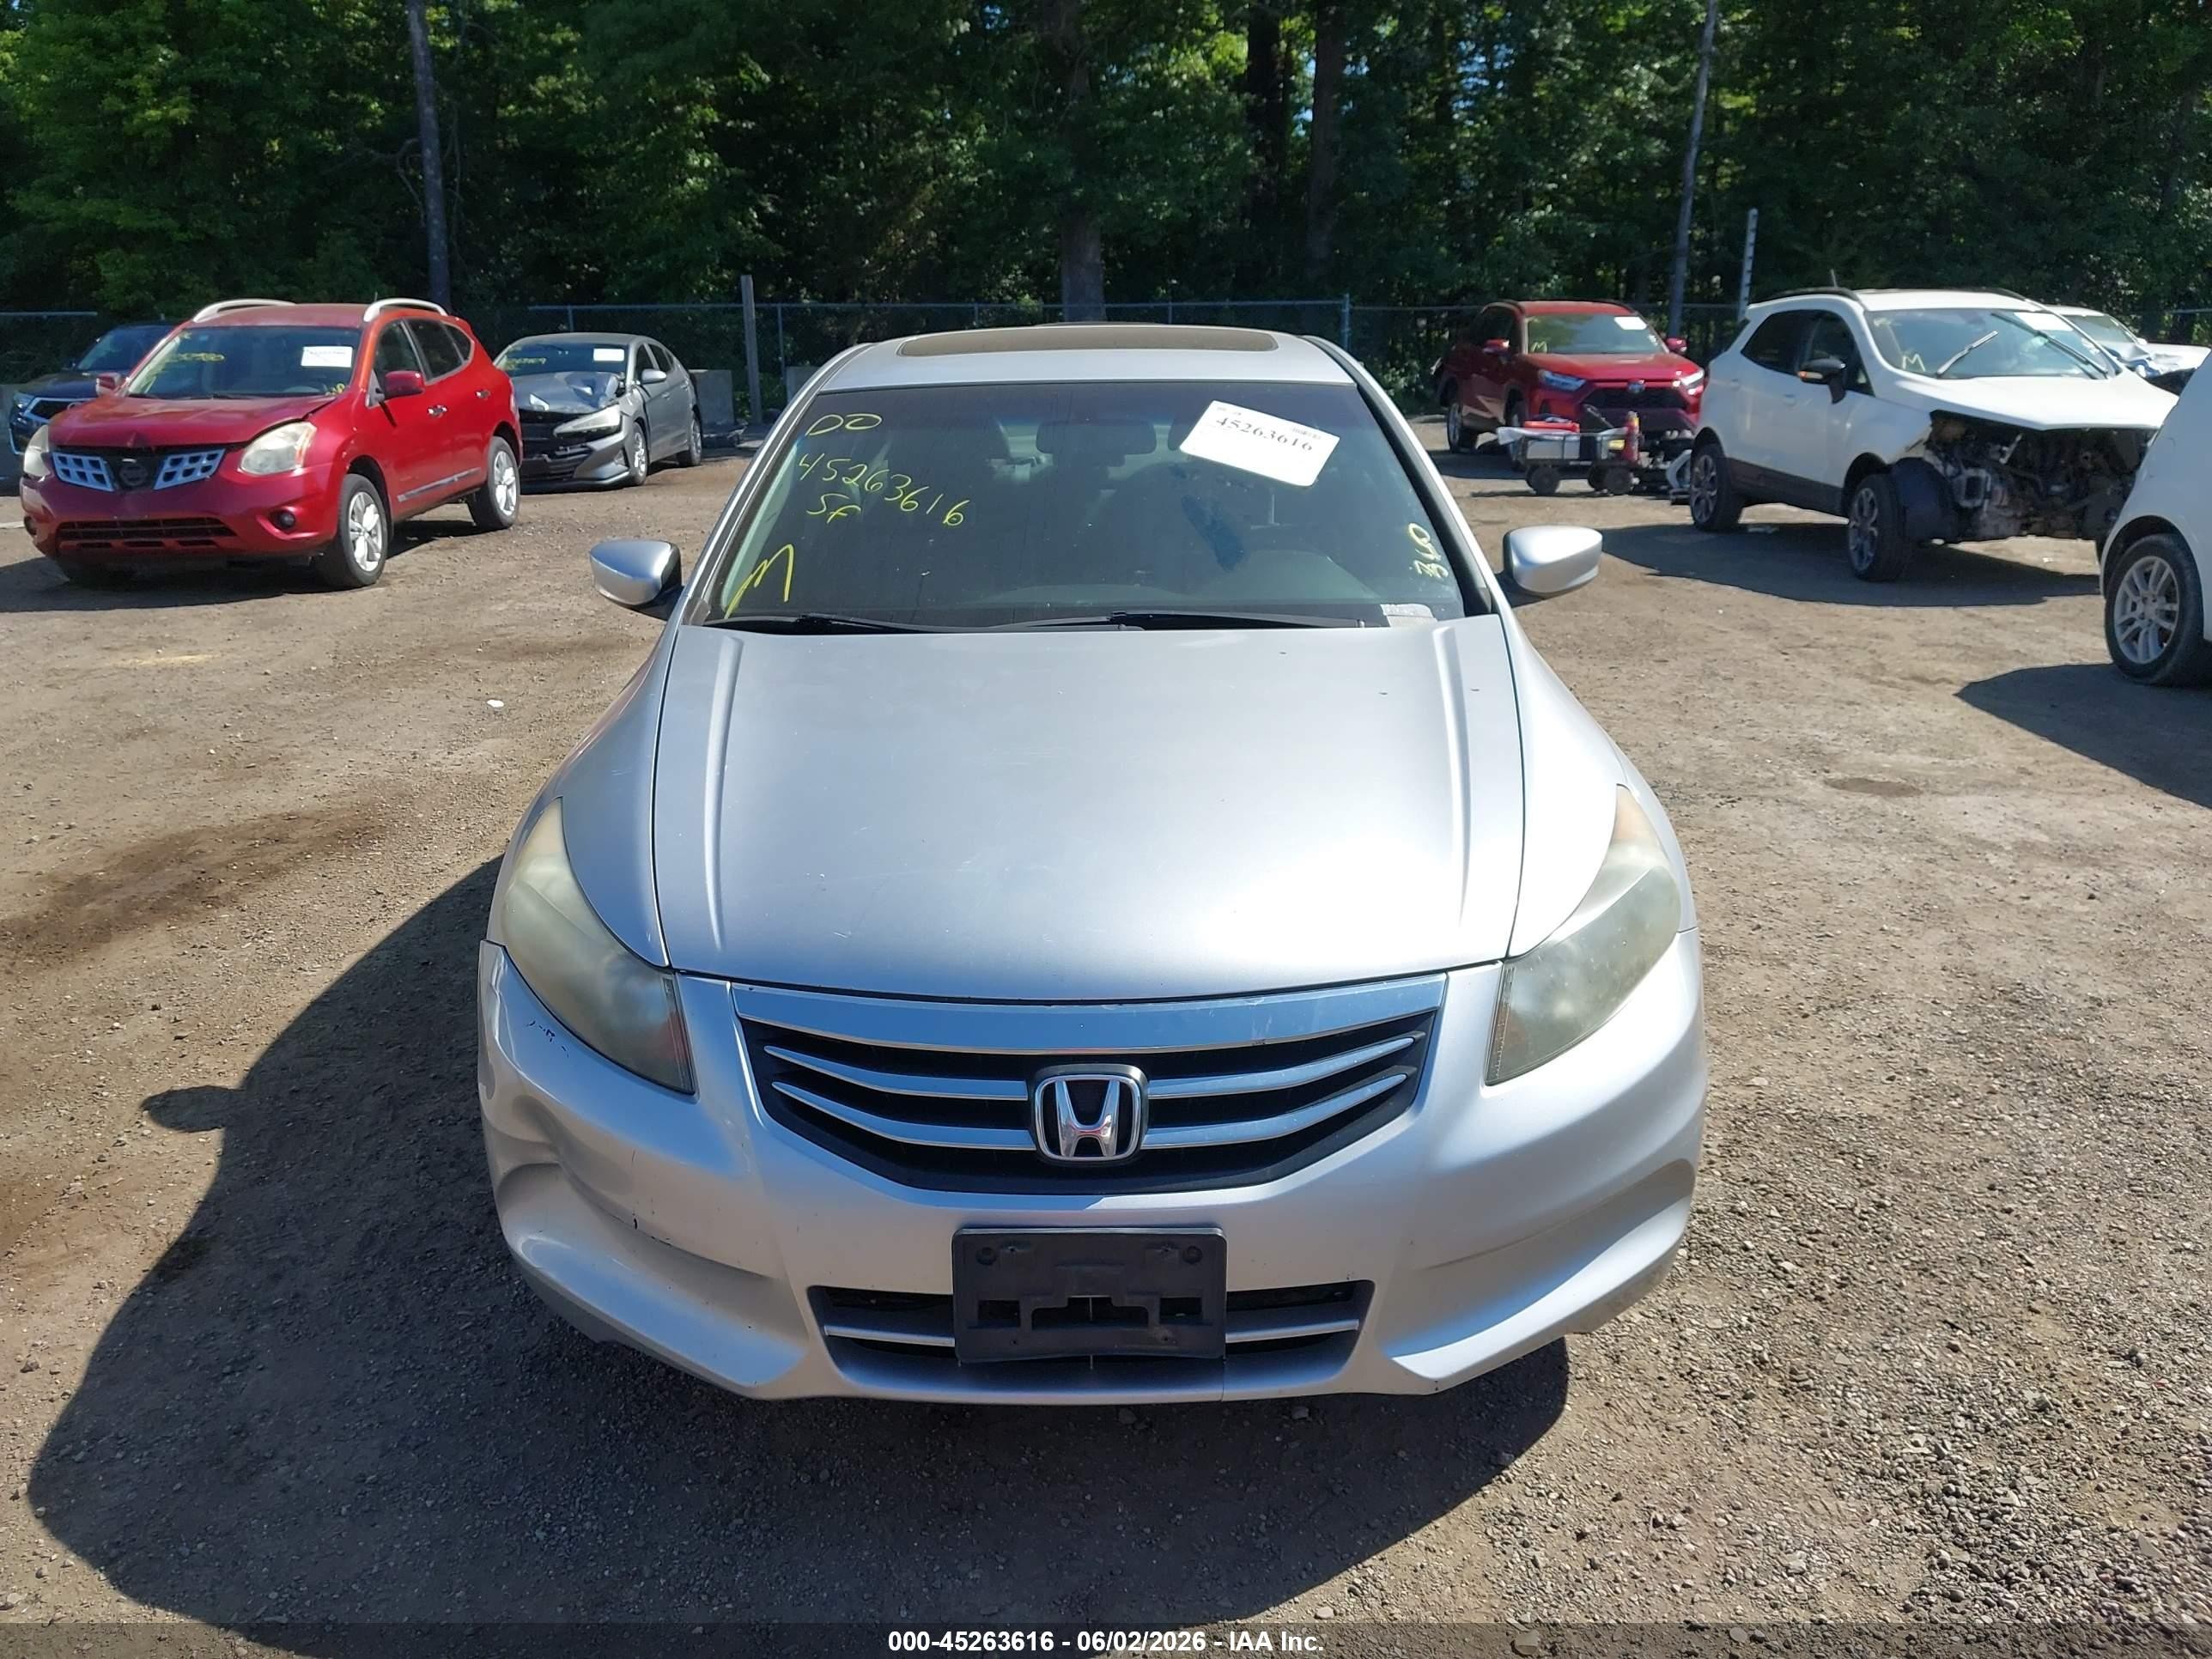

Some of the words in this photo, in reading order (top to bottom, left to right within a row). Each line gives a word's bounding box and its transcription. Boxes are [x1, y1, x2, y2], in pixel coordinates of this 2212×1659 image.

[1901, 353, 1926, 373] M
[1216, 417, 1313, 451] 45263616
[798, 453, 970, 526] 45263616
